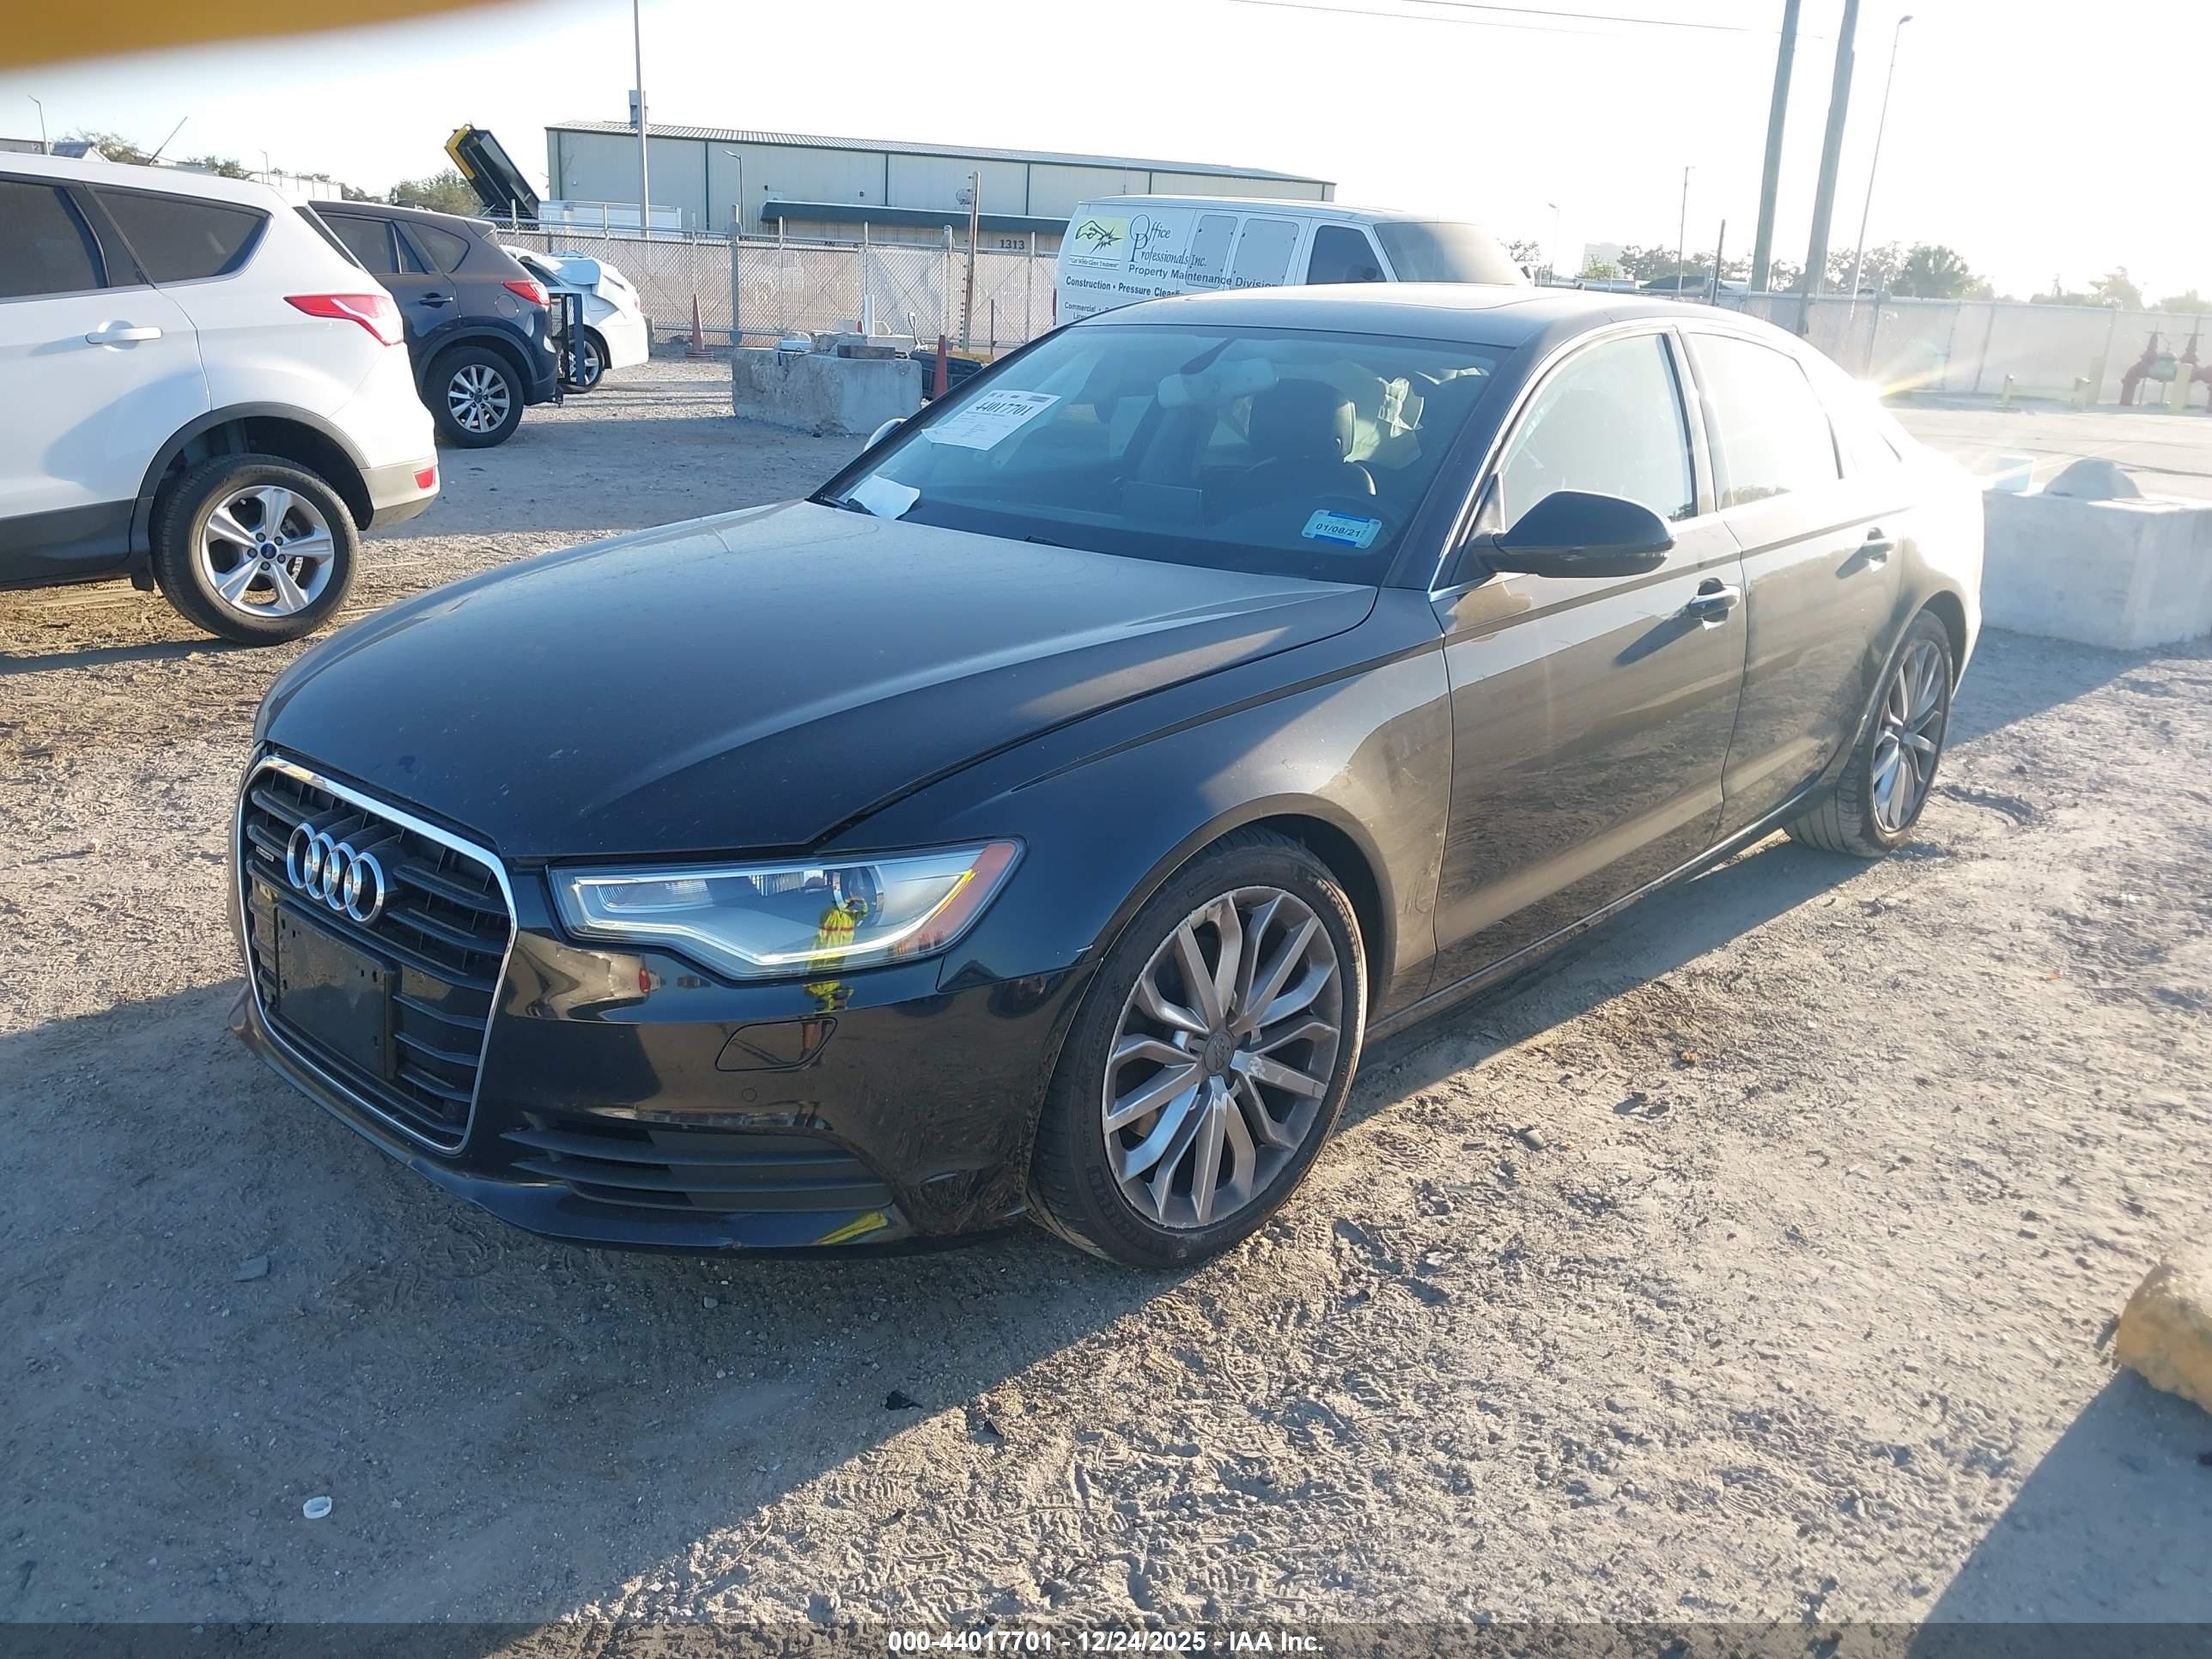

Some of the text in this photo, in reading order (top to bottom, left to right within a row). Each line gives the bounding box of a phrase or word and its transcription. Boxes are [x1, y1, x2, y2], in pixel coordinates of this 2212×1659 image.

[1129, 214, 1171, 241] Office
[1000, 239, 1024, 249] 1313
[1127, 233, 1207, 267] Professionals Inc.
[1128, 264, 1168, 279] Property
[1170, 270, 1232, 286] Maintenance
[1066, 276, 1111, 290] Construction
[1118, 283, 1152, 295] Pressure
[1064, 301, 1097, 312] Commercial
[975, 401, 1035, 416] 44017701
[1316, 522, 1361, 538] 01/08/21
